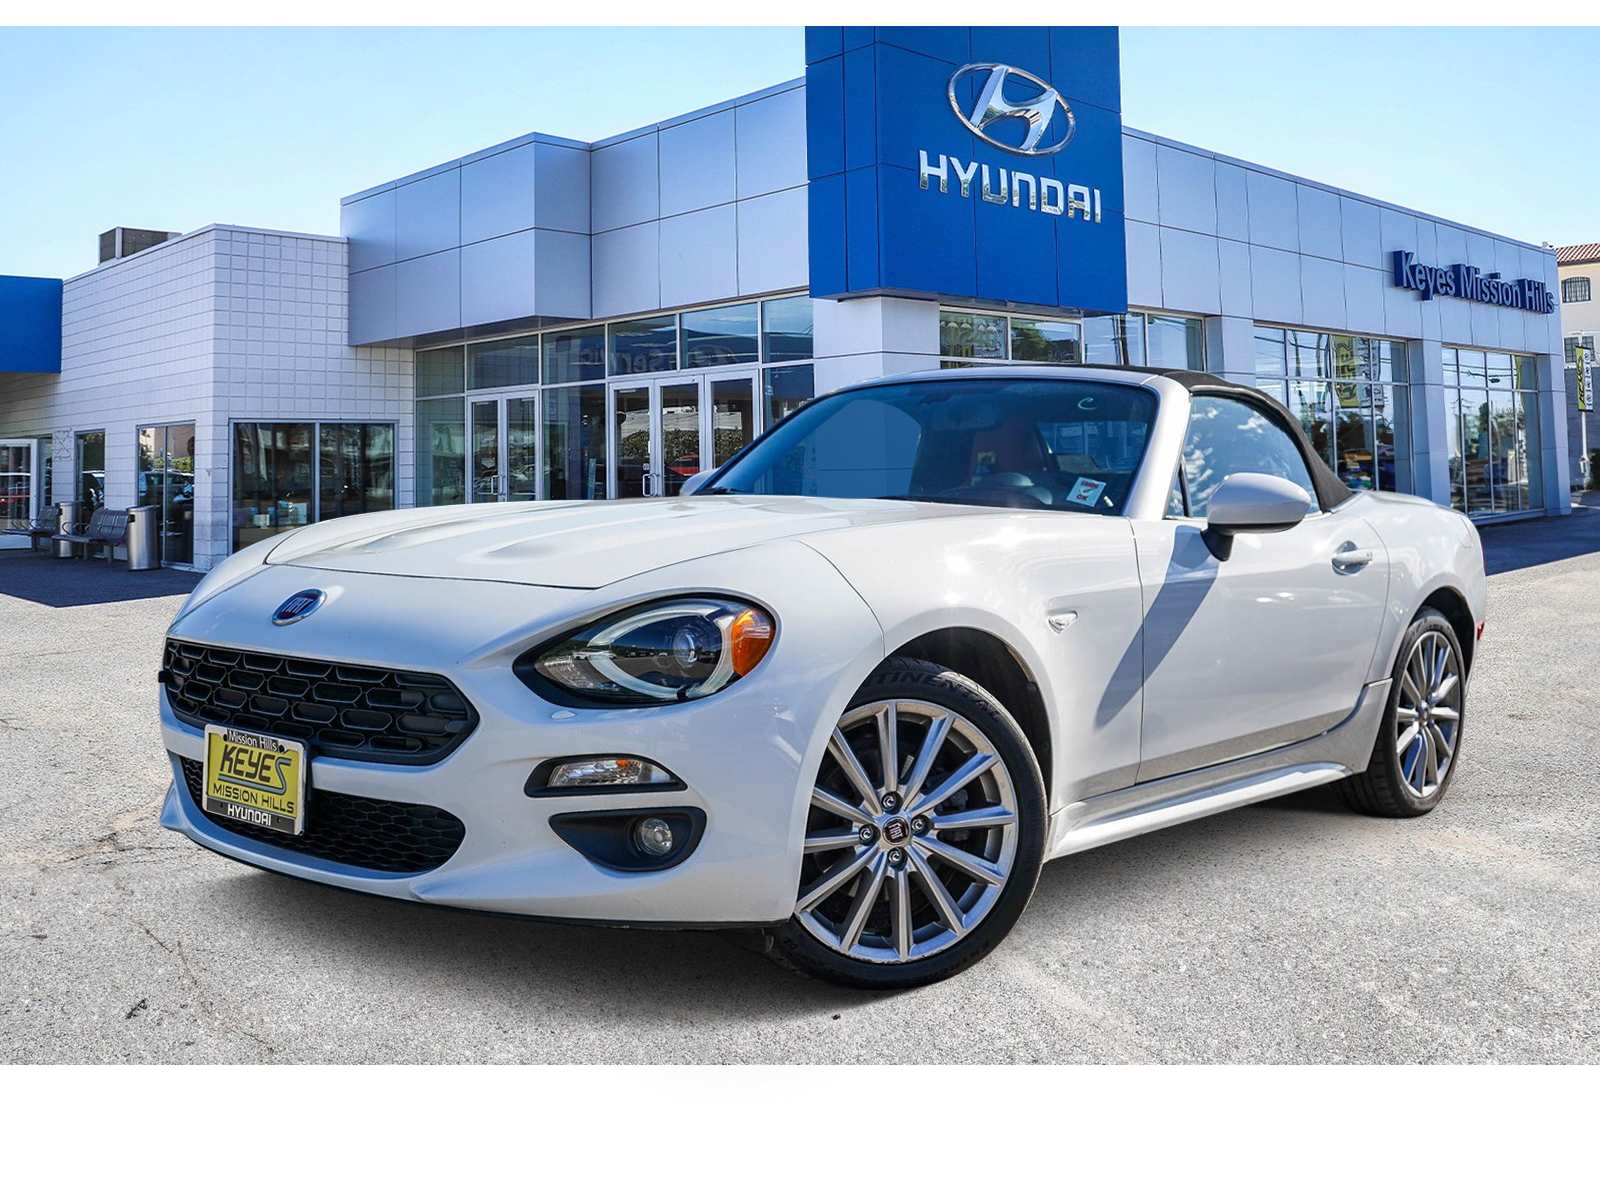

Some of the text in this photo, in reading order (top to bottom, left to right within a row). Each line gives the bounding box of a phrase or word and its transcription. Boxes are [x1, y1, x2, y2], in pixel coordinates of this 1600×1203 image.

[919, 149, 1102, 224] HYUNDAI
[1399, 250, 1555, 314] Keyes Mission Hills
[226, 728, 279, 752] Mission Hills
[219, 743, 292, 792] KEYES
[213, 783, 295, 814] MISSION HILLS
[227, 803, 272, 827] HYUNDAI
